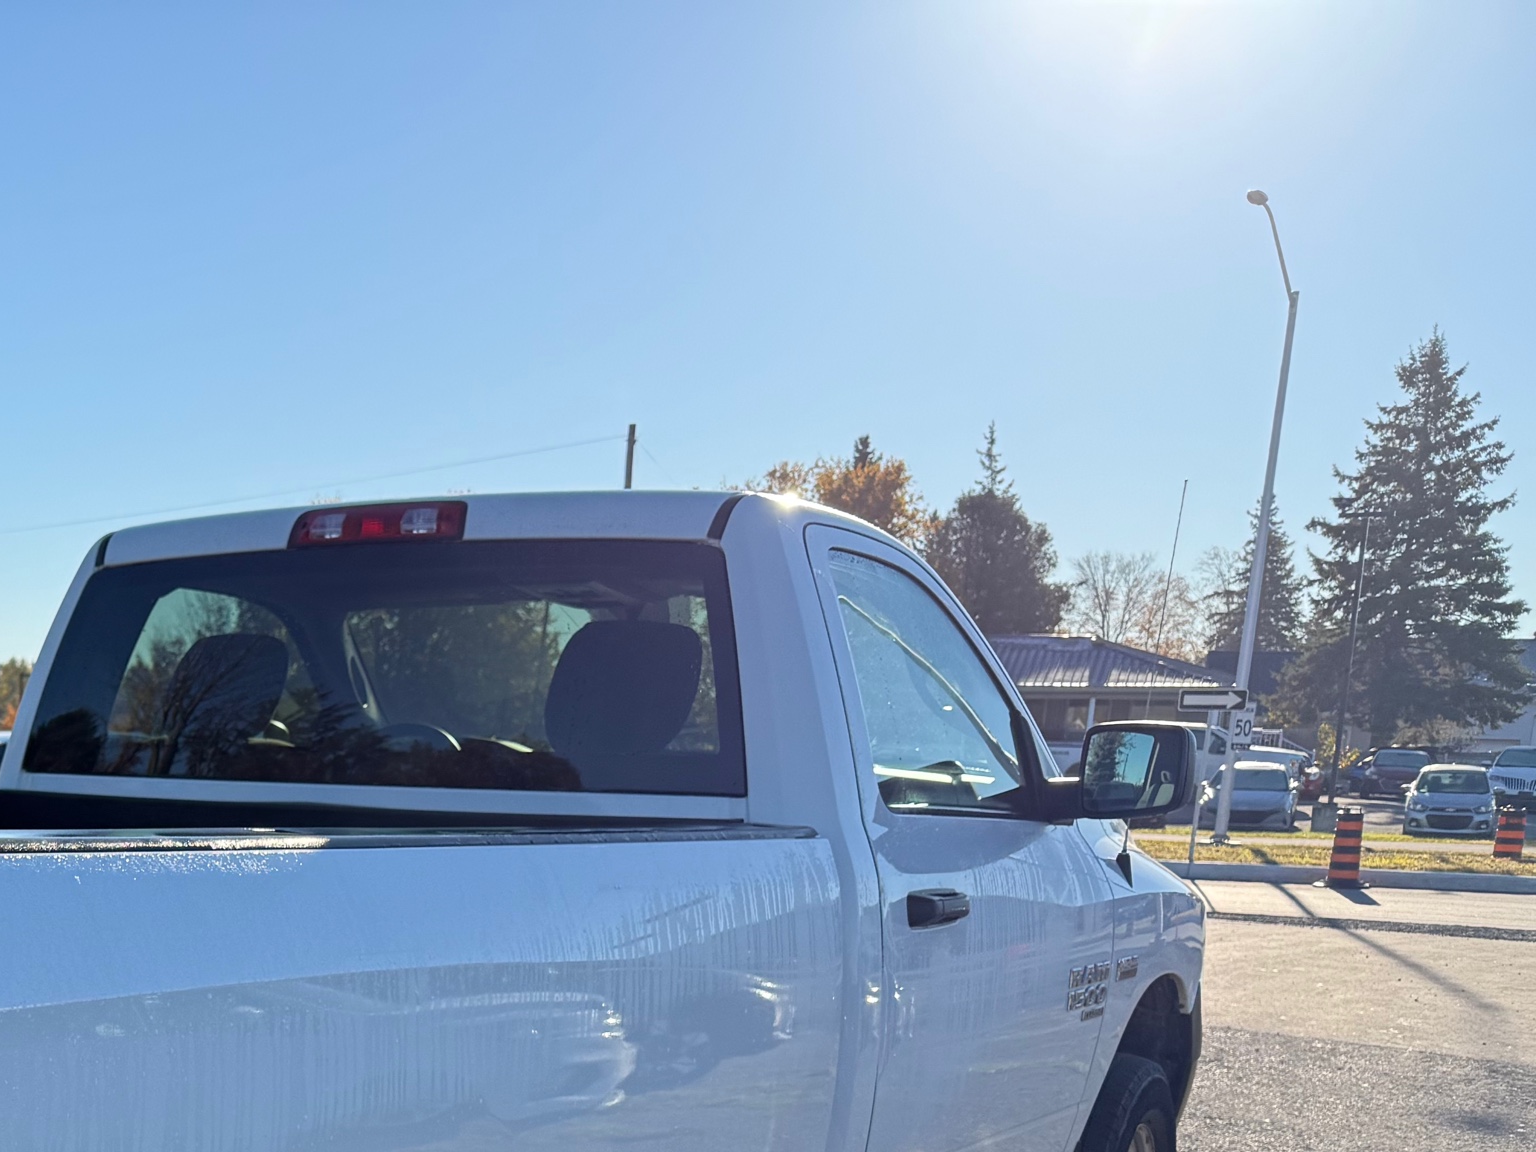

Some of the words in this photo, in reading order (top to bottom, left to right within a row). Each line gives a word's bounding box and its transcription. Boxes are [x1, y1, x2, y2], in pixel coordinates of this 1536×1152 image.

[1235, 719, 1252, 737] 50
[1070, 961, 1110, 988] RAM
[1067, 984, 1106, 1011] 1500
